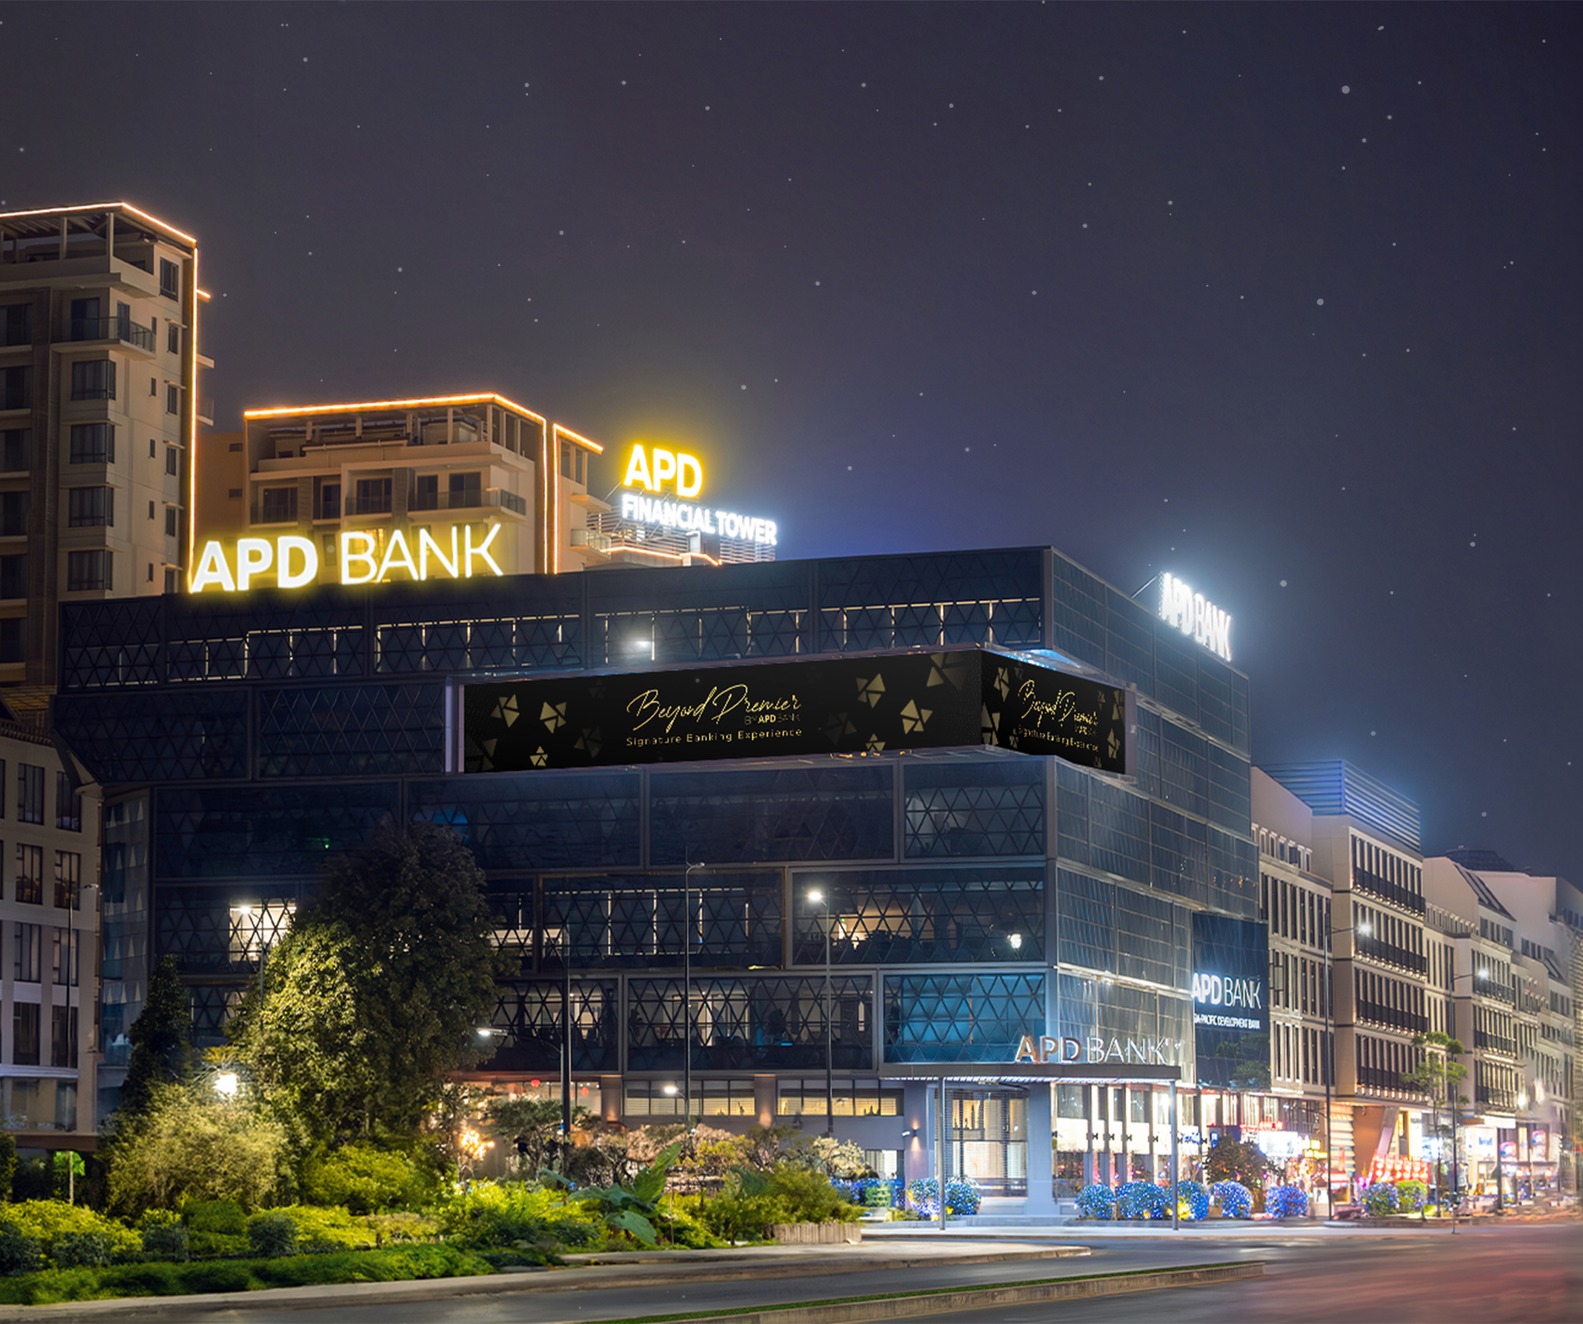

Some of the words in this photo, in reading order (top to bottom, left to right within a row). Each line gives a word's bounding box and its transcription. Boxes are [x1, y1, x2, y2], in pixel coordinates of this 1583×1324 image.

[623, 444, 703, 498] APD
[621, 493, 716, 535] FINANCIAL
[716, 510, 778, 546] TOWER
[190, 535, 318, 593] APD
[341, 523, 504, 585] BANK
[1160, 572, 1193, 635] APD
[1194, 593, 1232, 662] BANK
[626, 686, 718, 733] Beyond
[711, 684, 802, 724] Premier
[626, 736, 682, 748] Signature
[686, 732, 733, 743] Banking
[738, 729, 802, 741] Experience
[1191, 972, 1222, 1005] APD
[1224, 976, 1262, 1010] BANK
[1015, 1035, 1082, 1063] APD
[1087, 1036, 1168, 1064] BANK
